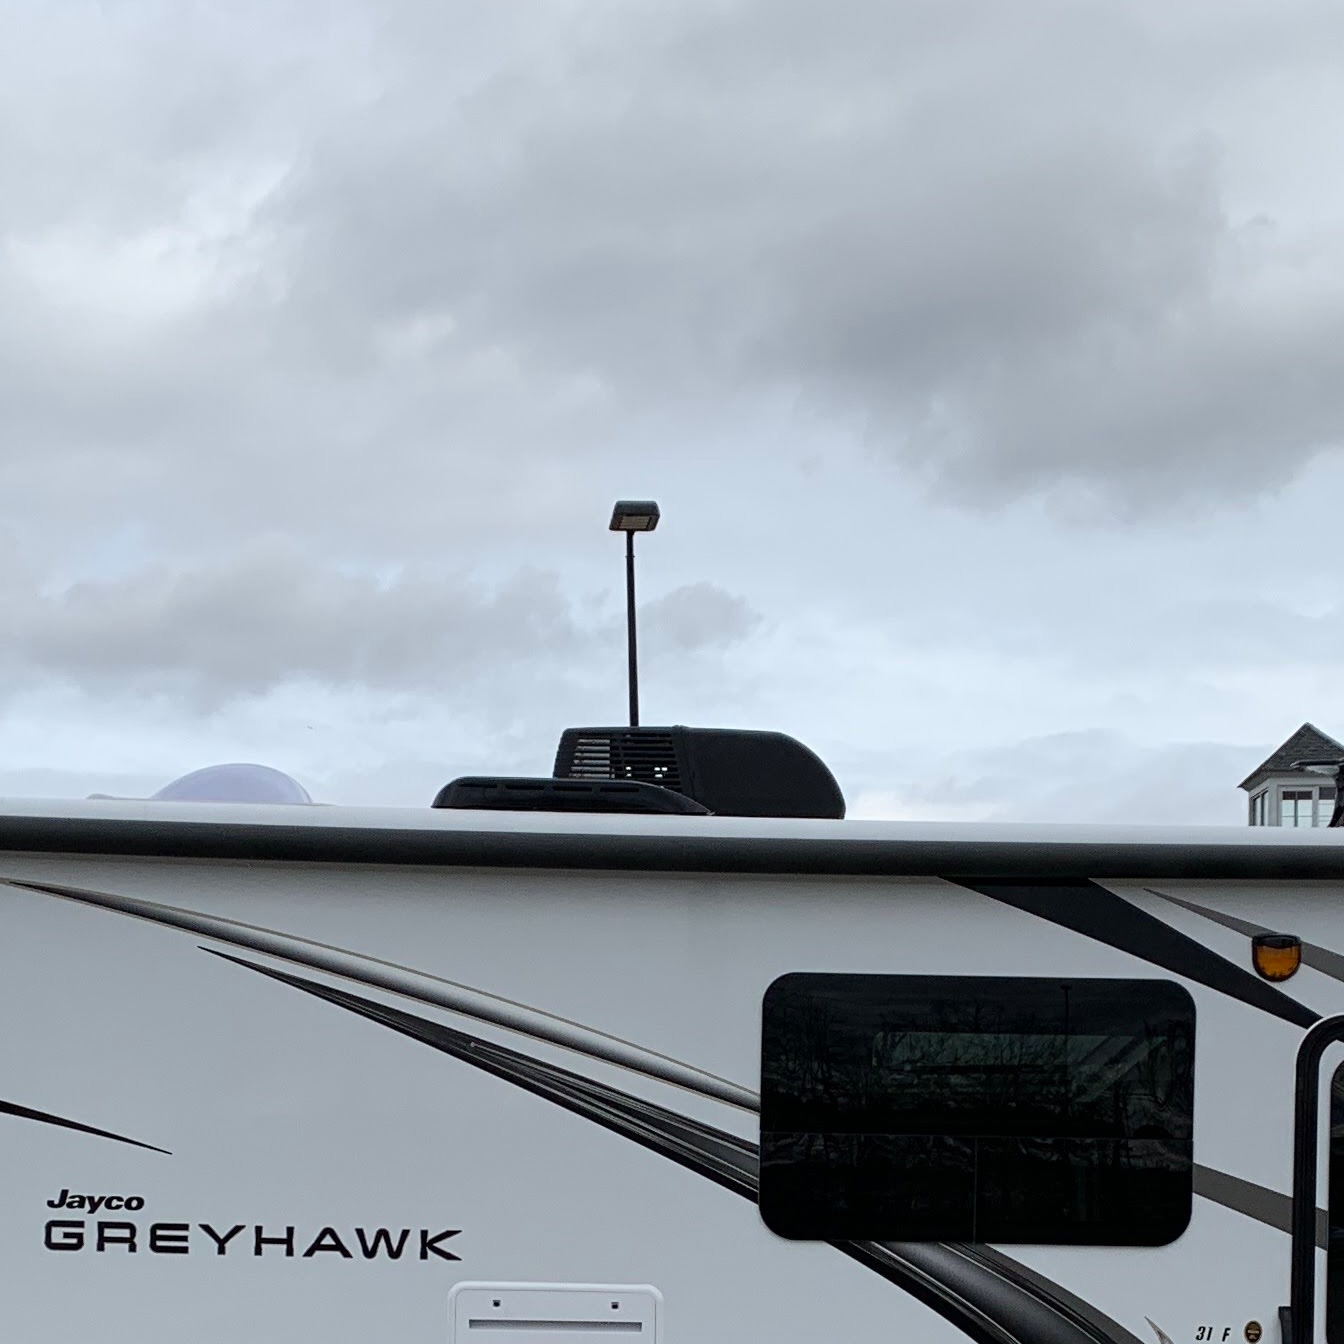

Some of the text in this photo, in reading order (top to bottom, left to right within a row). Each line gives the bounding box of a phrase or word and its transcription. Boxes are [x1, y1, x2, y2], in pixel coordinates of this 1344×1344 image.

[47, 1189, 145, 1214] Jayco
[44, 1219, 463, 1261] GREYHAWK
[1195, 1326, 1213, 1341] 31
[1222, 1327, 1232, 1342] F
